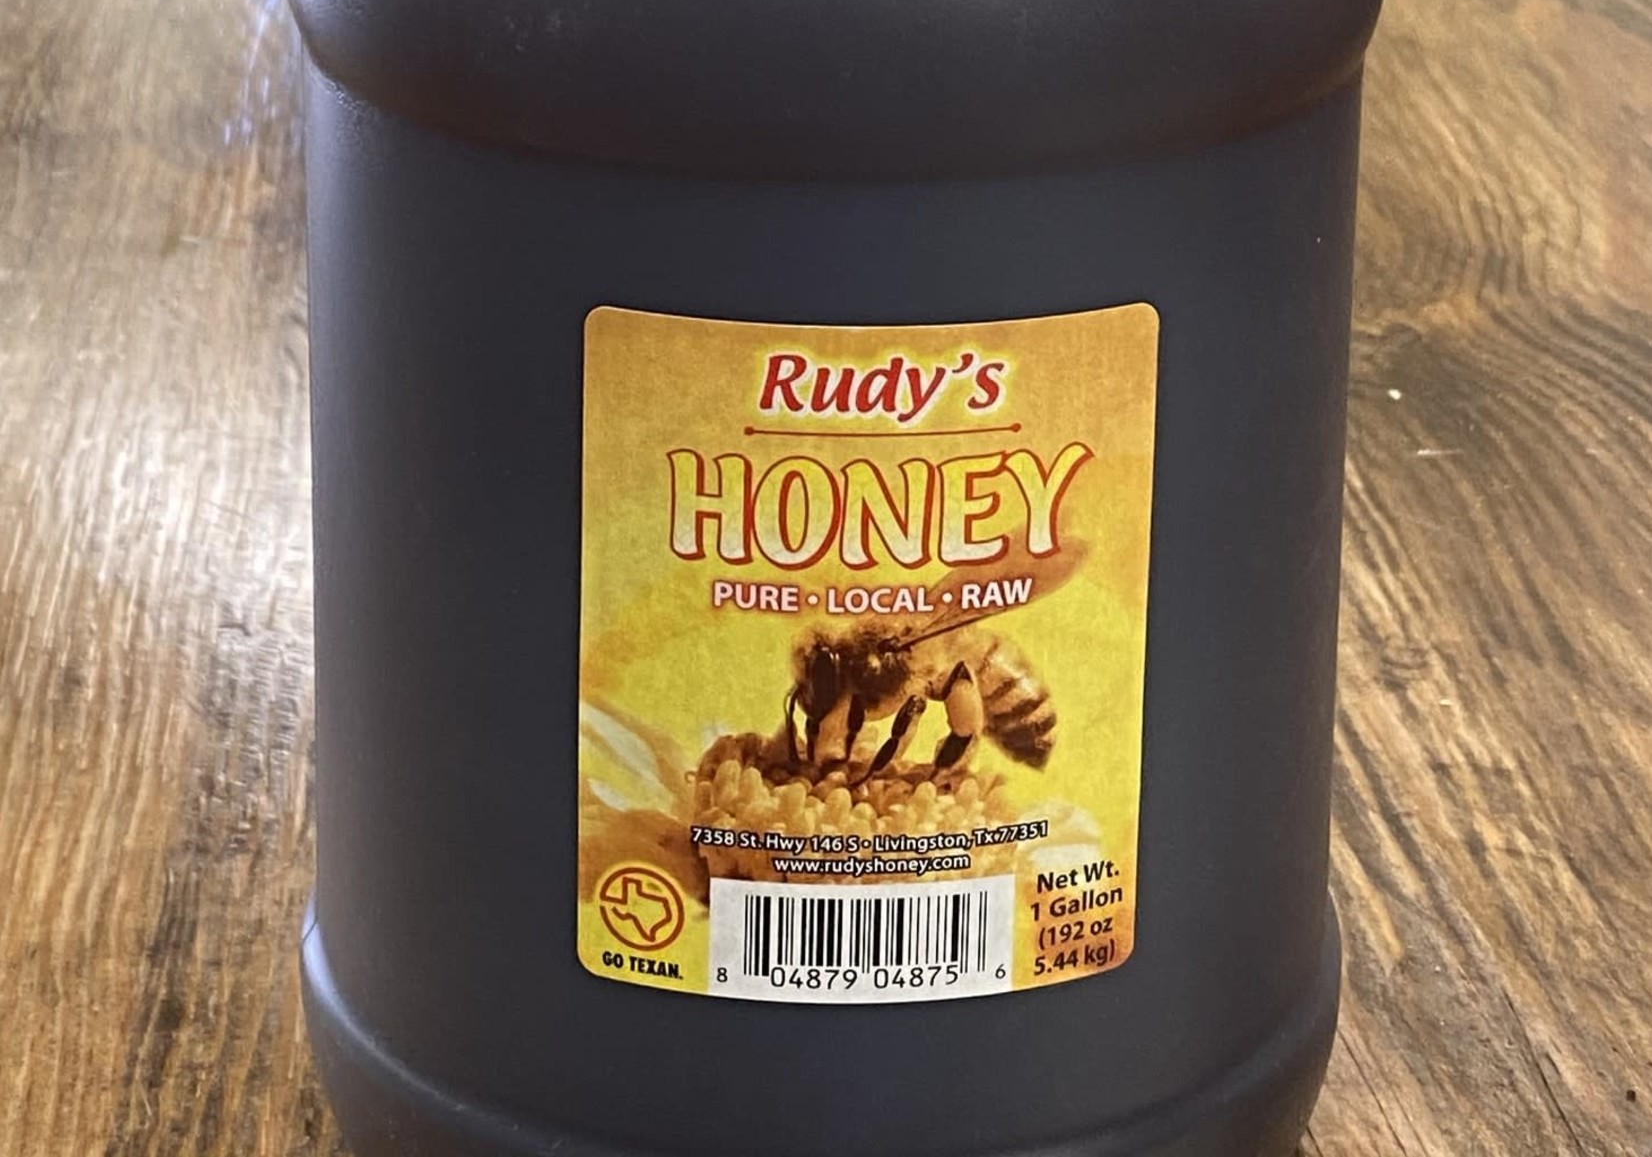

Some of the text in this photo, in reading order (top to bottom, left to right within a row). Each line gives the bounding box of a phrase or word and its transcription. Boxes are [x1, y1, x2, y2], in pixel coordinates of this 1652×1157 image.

[759, 353, 1005, 422] Rudy's
[666, 441, 1094, 571] HONEY
[713, 578, 1033, 613] PURE LOCAL RAW
[692, 828, 734, 845] 7358
[740, 833, 762, 848] St.
[766, 835, 805, 853] Hwy
[812, 837, 842, 852] 146
[848, 837, 858, 852] S
[875, 834, 972, 853] Livingston,
[775, 855, 969, 876] www.rudyshoney.com
[1037, 860, 1120, 894] Net Wt.
[1030, 887, 1122, 922] 1 Gallon
[1039, 917, 1113, 951] (192 oz
[602, 951, 624, 968] GO
[1034, 938, 1115, 976] 5.44 kg)
[717, 964, 1006, 990] 8 04879 04875 6
